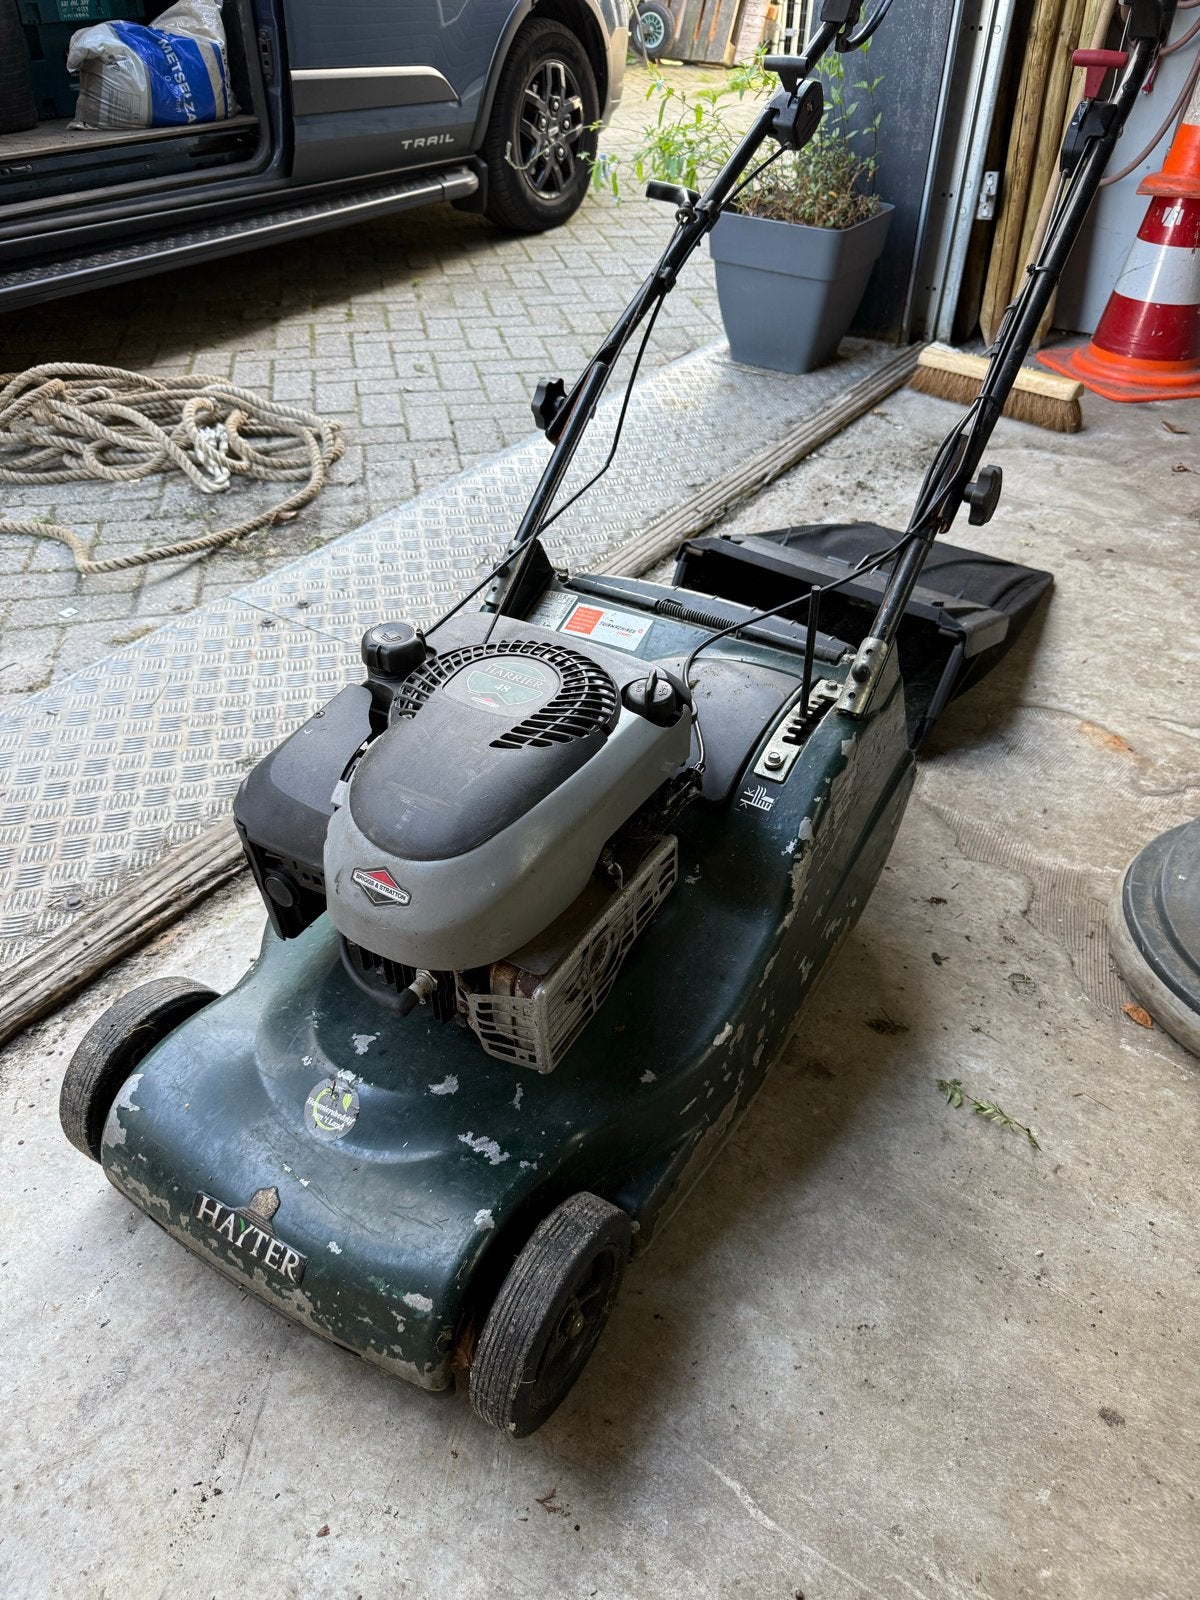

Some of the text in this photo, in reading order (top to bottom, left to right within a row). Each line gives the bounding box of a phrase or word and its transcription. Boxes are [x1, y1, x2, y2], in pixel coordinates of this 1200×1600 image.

[401, 133, 455, 150] TRAIL
[484, 664, 544, 689] HARRIER
[494, 683, 512, 692] 48
[356, 873, 375, 886] BRIGGS
[379, 884, 406, 900] STRATTON
[196, 1195, 300, 1284] HAYTER
